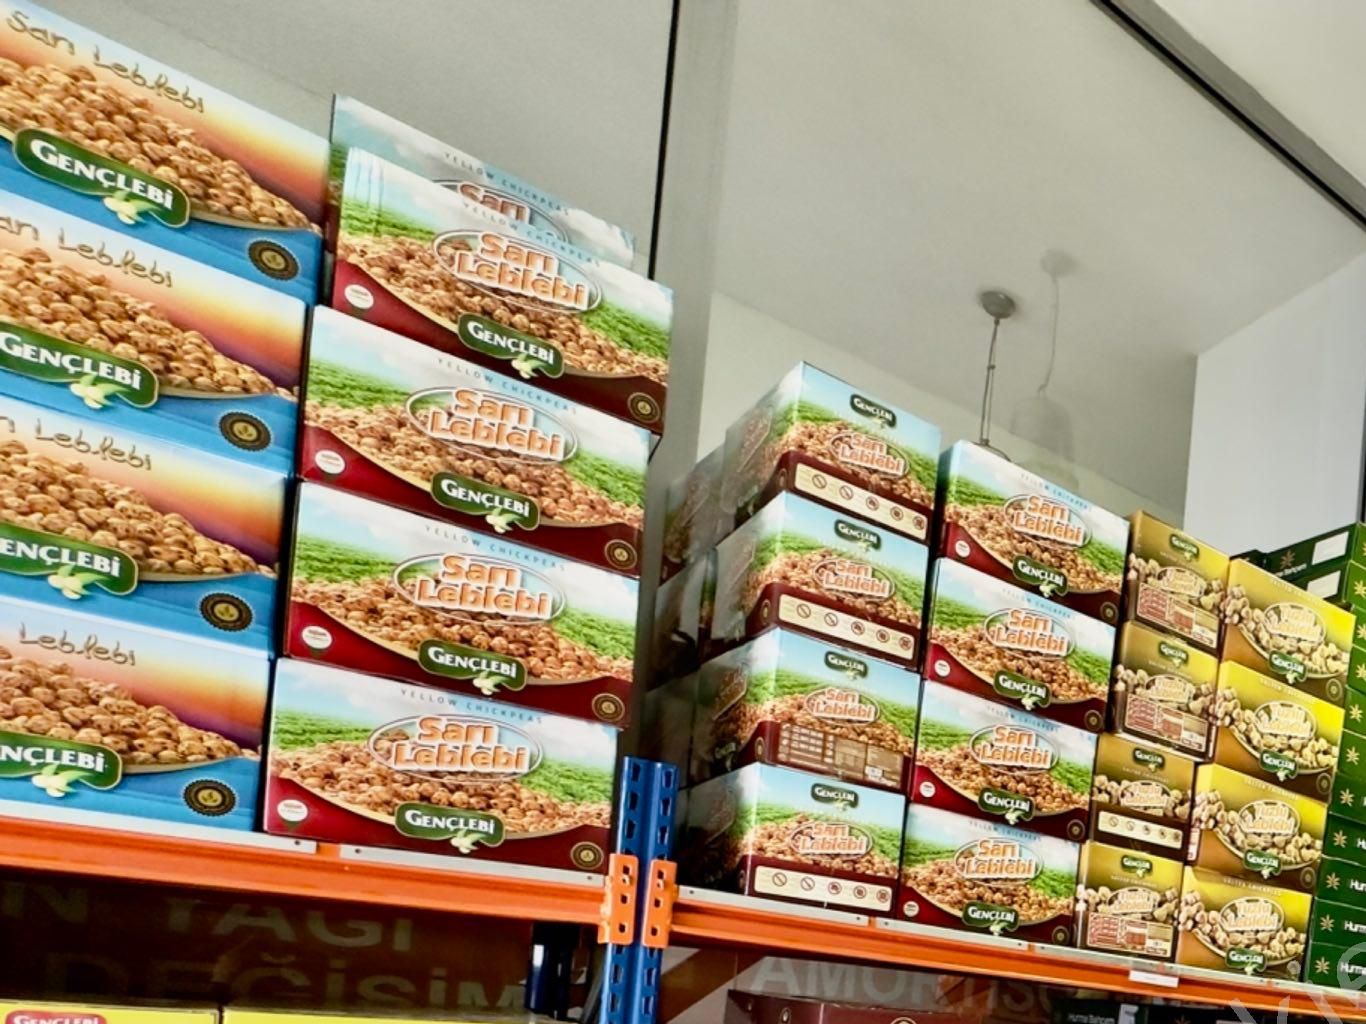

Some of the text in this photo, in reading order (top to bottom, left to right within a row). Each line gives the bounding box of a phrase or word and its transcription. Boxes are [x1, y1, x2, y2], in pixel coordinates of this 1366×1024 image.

[474, 231, 561, 276] Sarı
[453, 255, 591, 310] Leblebi
[453, 388, 533, 427] Sarı
[429, 409, 565, 461] Leblebi
[0, 539, 121, 578] ENÇLEBİ
[440, 554, 521, 590] Sarı
[415, 577, 553, 618] Leblebi
[416, 715, 496, 746] Sarı
[0, 745, 105, 773] NÇLEBİ
[392, 743, 530, 774] Leblebi
